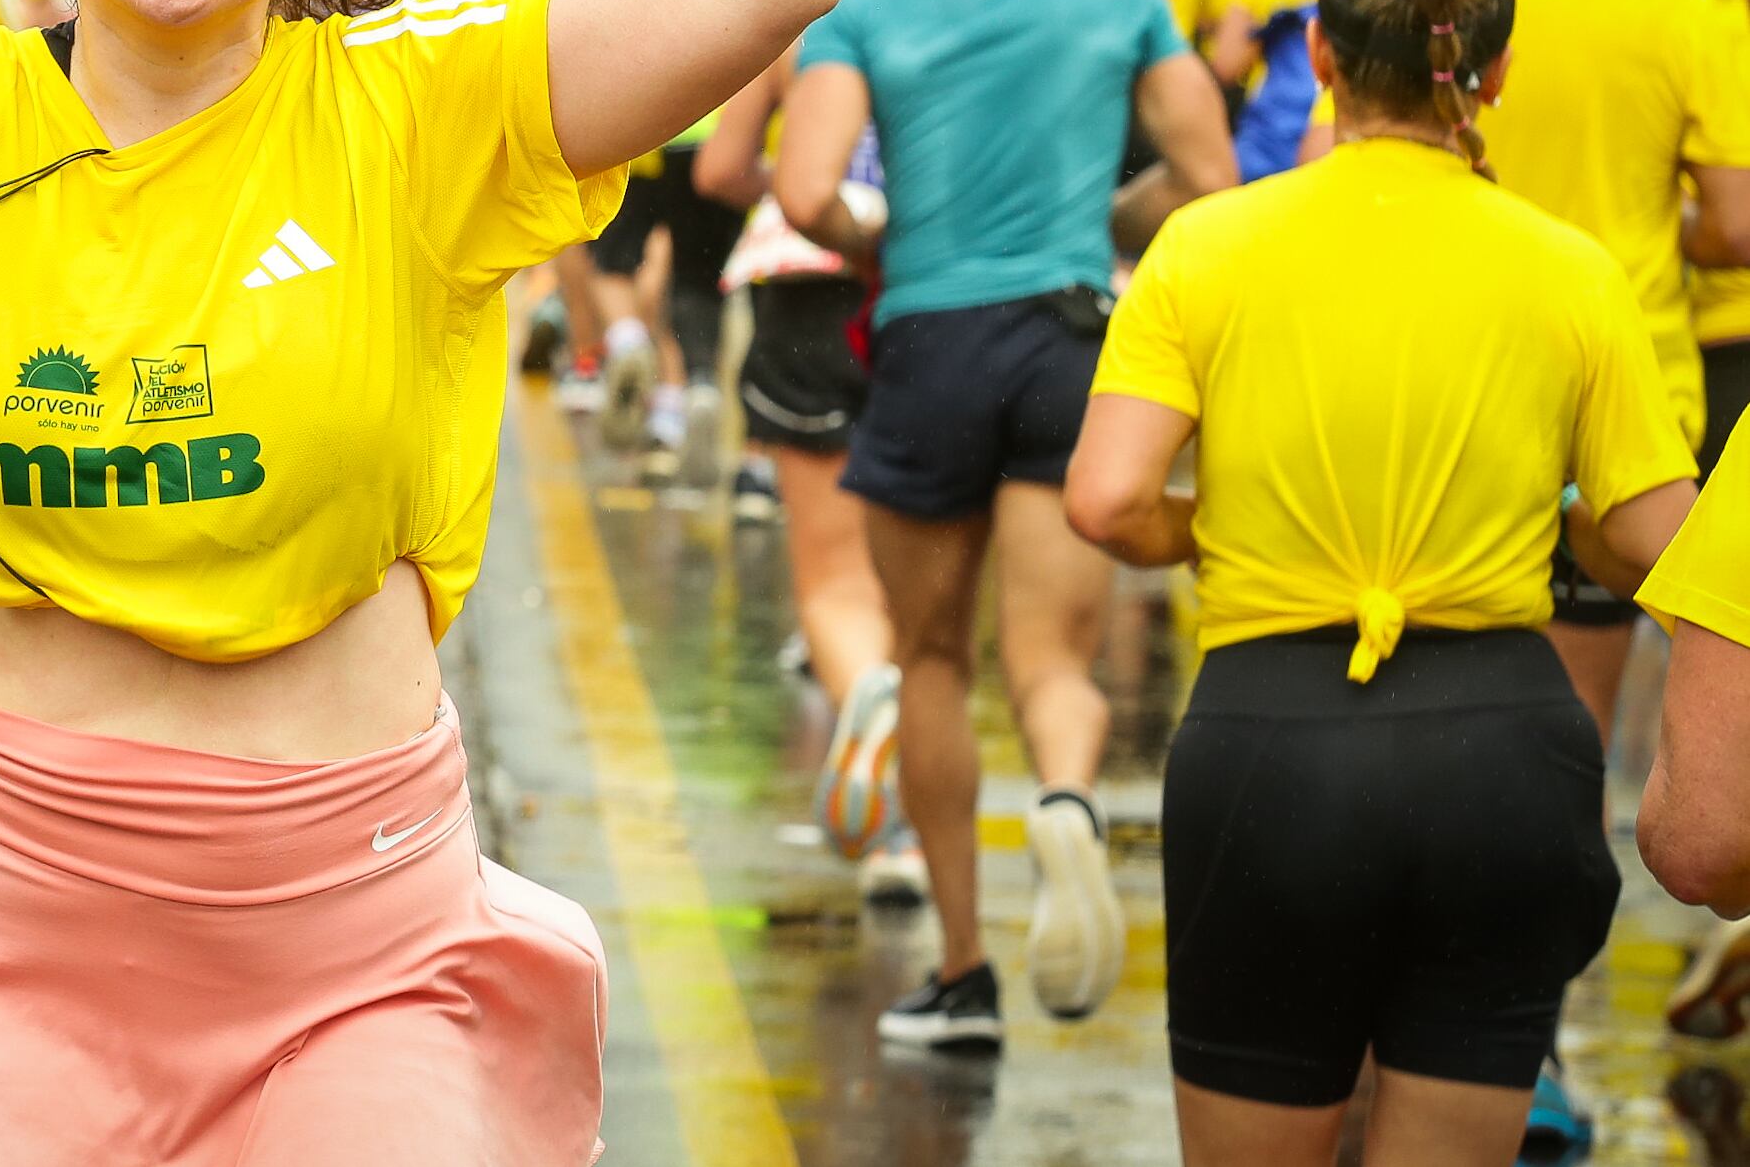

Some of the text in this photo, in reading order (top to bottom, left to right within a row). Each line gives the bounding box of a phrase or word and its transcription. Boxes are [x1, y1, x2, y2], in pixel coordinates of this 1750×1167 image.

[144, 383, 204, 398] ATLETISMO
[4, 395, 105, 418] porvenir
[143, 396, 205, 416] porvenir
[38, 419, 58, 428] sólo
[61, 421, 78, 431] hay
